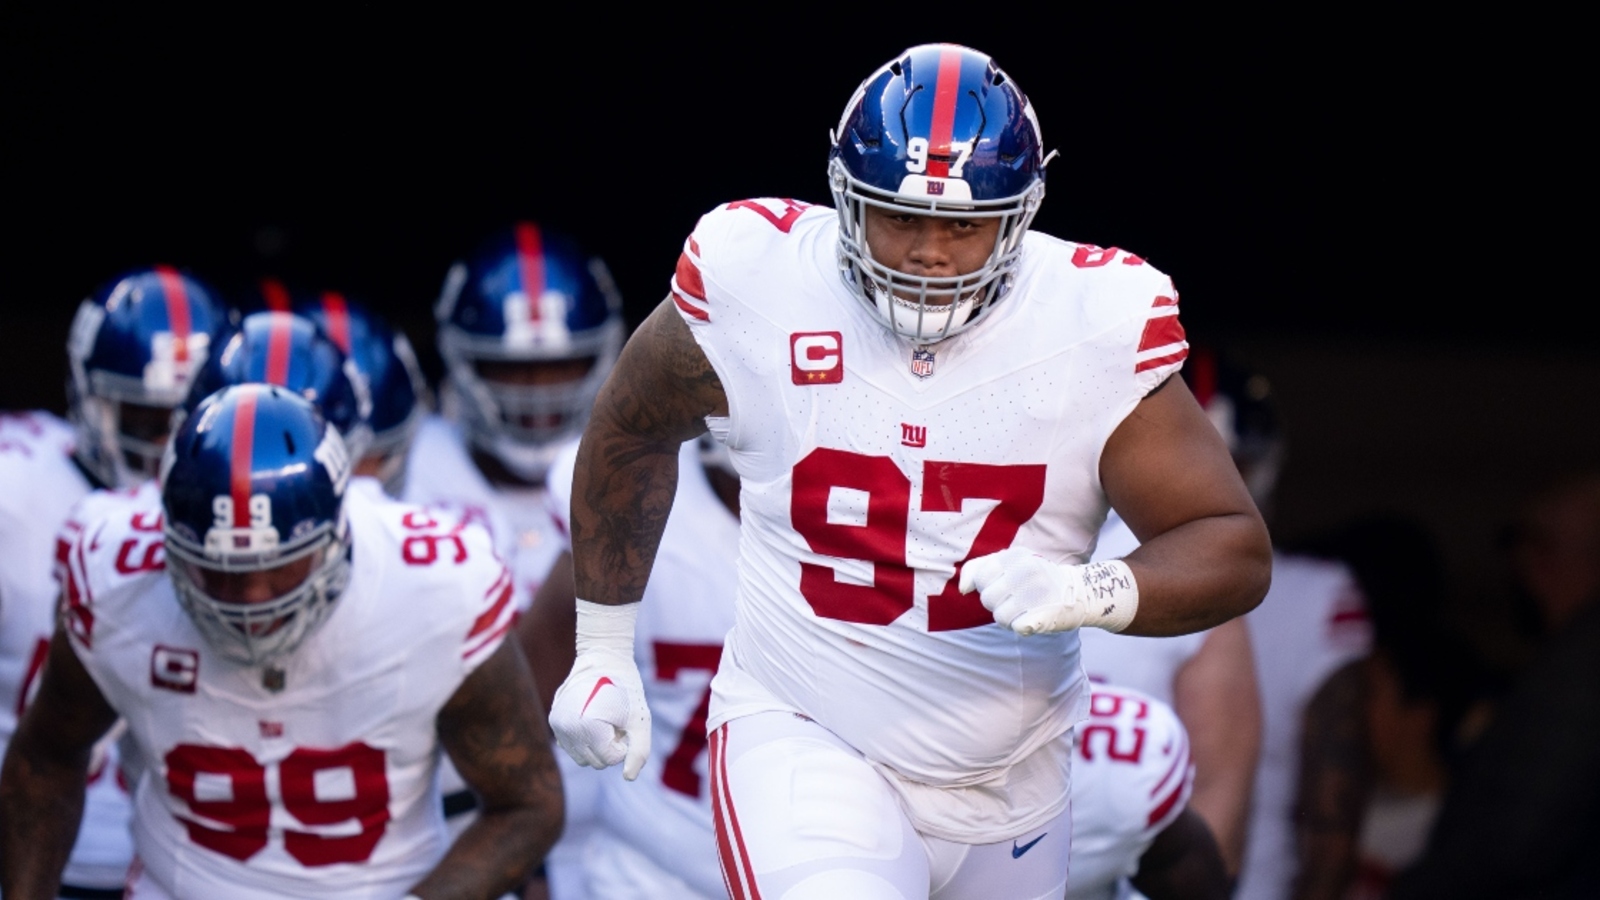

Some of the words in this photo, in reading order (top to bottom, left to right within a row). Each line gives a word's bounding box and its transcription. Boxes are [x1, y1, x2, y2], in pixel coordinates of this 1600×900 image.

[906, 137, 974, 178] 97
[794, 335, 839, 371] C
[912, 360, 932, 375] NFL
[213, 494, 272, 529] 99
[791, 447, 1046, 631] 97
[154, 648, 196, 685] C
[1081, 692, 1147, 764] 29
[164, 740, 391, 868] 99
